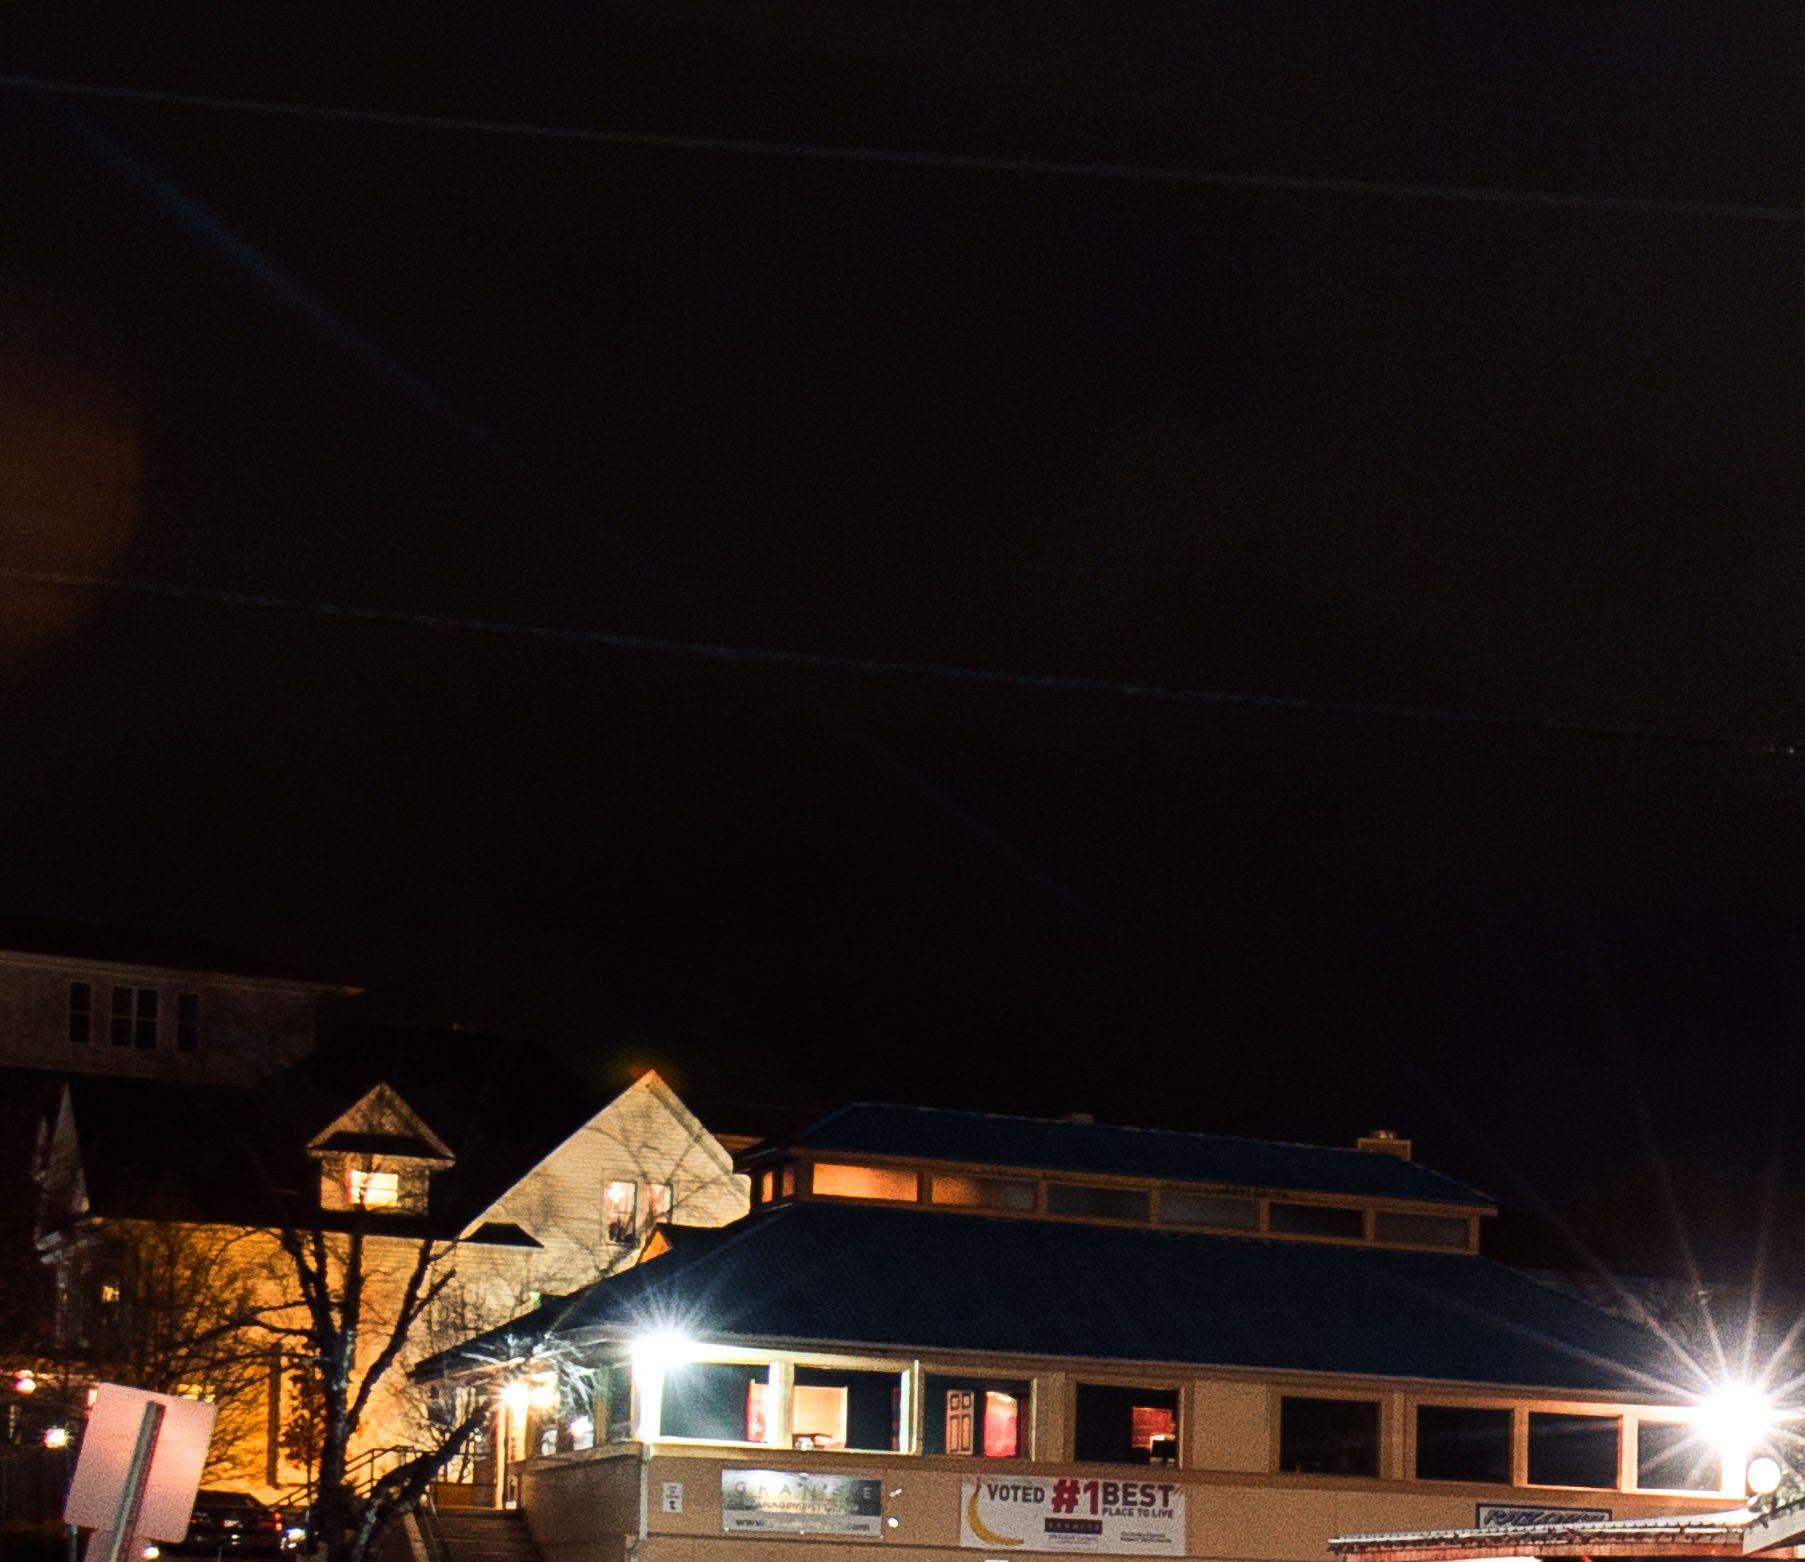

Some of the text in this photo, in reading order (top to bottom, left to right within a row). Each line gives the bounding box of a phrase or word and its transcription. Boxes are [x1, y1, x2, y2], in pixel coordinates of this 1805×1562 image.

[987, 1479, 1175, 1515] VOTED #1 BEST
[1102, 1506, 1174, 1519] PLACE TO LIVE
